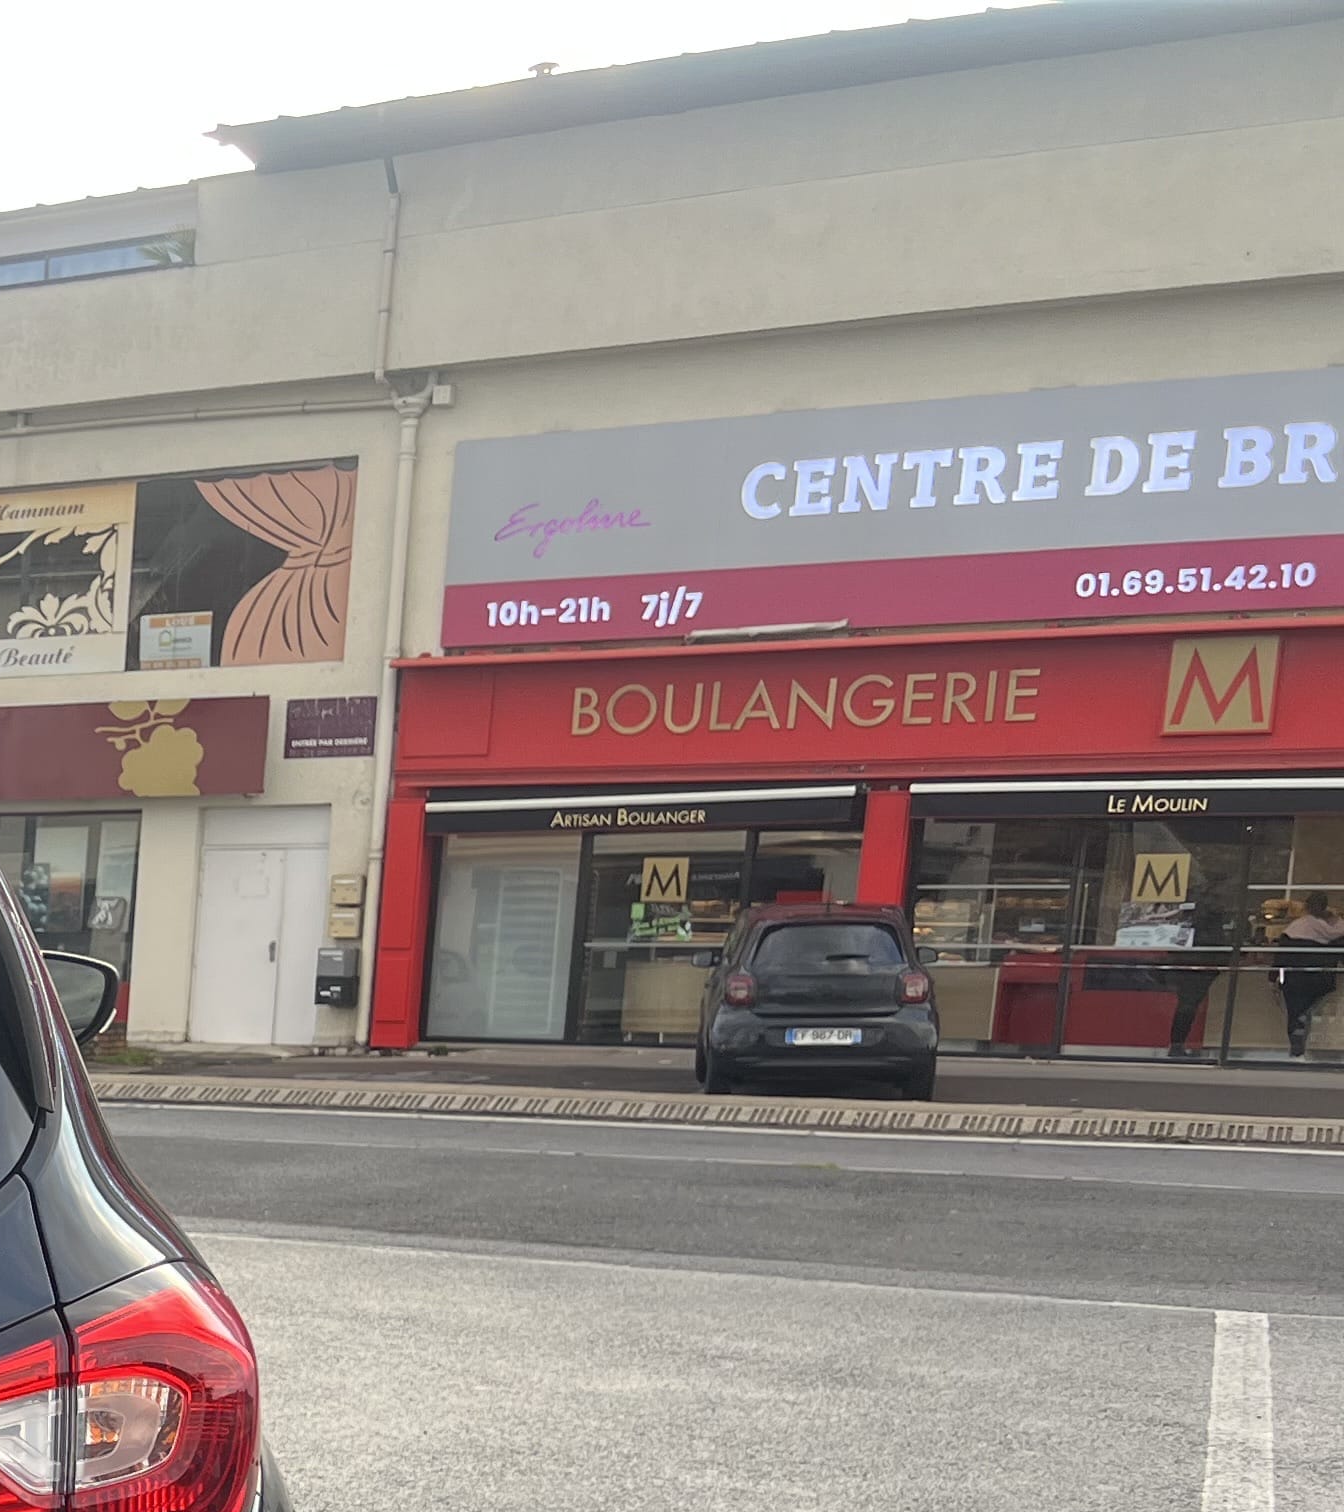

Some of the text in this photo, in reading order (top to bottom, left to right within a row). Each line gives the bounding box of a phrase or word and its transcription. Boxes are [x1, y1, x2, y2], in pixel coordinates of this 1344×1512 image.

[740, 420, 1339, 520] CENTRE DE BR
[494, 498, 652, 559] Ergoline
[1075, 561, 1317, 599] 01.69.51.42.10
[487, 585, 703, 627] 10h-21h 7j/7
[0, 645, 75, 668] Beauté
[572, 668, 1041, 736] BOULANGERIE
[1170, 646, 1264, 726] M
[645, 864, 681, 897] M
[1137, 860, 1180, 897] M
